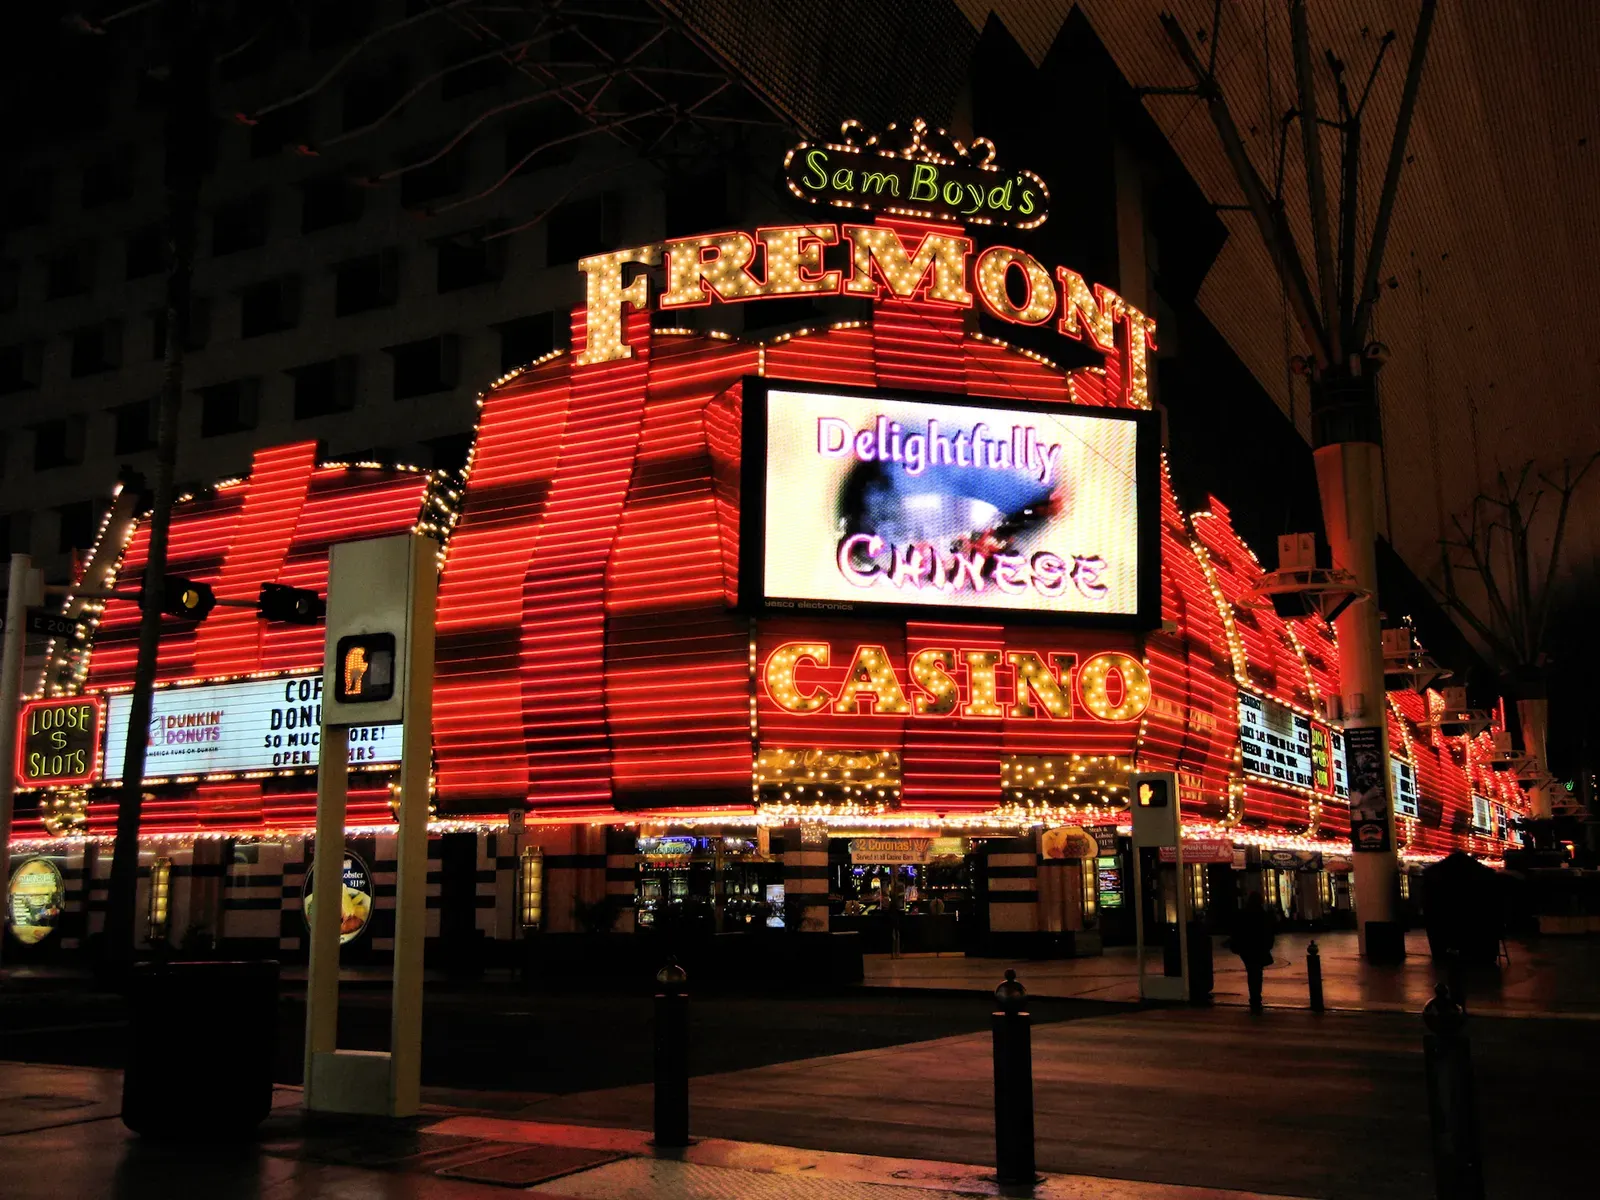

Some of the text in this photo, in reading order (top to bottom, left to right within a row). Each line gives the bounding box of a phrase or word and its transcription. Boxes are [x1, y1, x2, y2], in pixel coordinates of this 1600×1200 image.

[803, 149, 1037, 215] Sam Boyd's
[577, 223, 1157, 411] FREMONT
[817, 415, 1062, 485] Delightfully
[836, 532, 1110, 600] CHINESE
[765, 600, 854, 611] yesco electronics
[285, 677, 322, 702] COF
[763, 642, 1152, 725] CASINO
[32, 705, 91, 736] LOOSE
[167, 710, 224, 729] DUNKIN'
[51, 731, 68, 750] $
[166, 726, 220, 745] DONUTS
[264, 727, 386, 748] SO MUC ORE!
[30, 749, 86, 777] SLOTS
[273, 750, 311, 766] OPEN
[868, 838, 912, 851] Coronas!
[343, 870, 364, 879] obster
